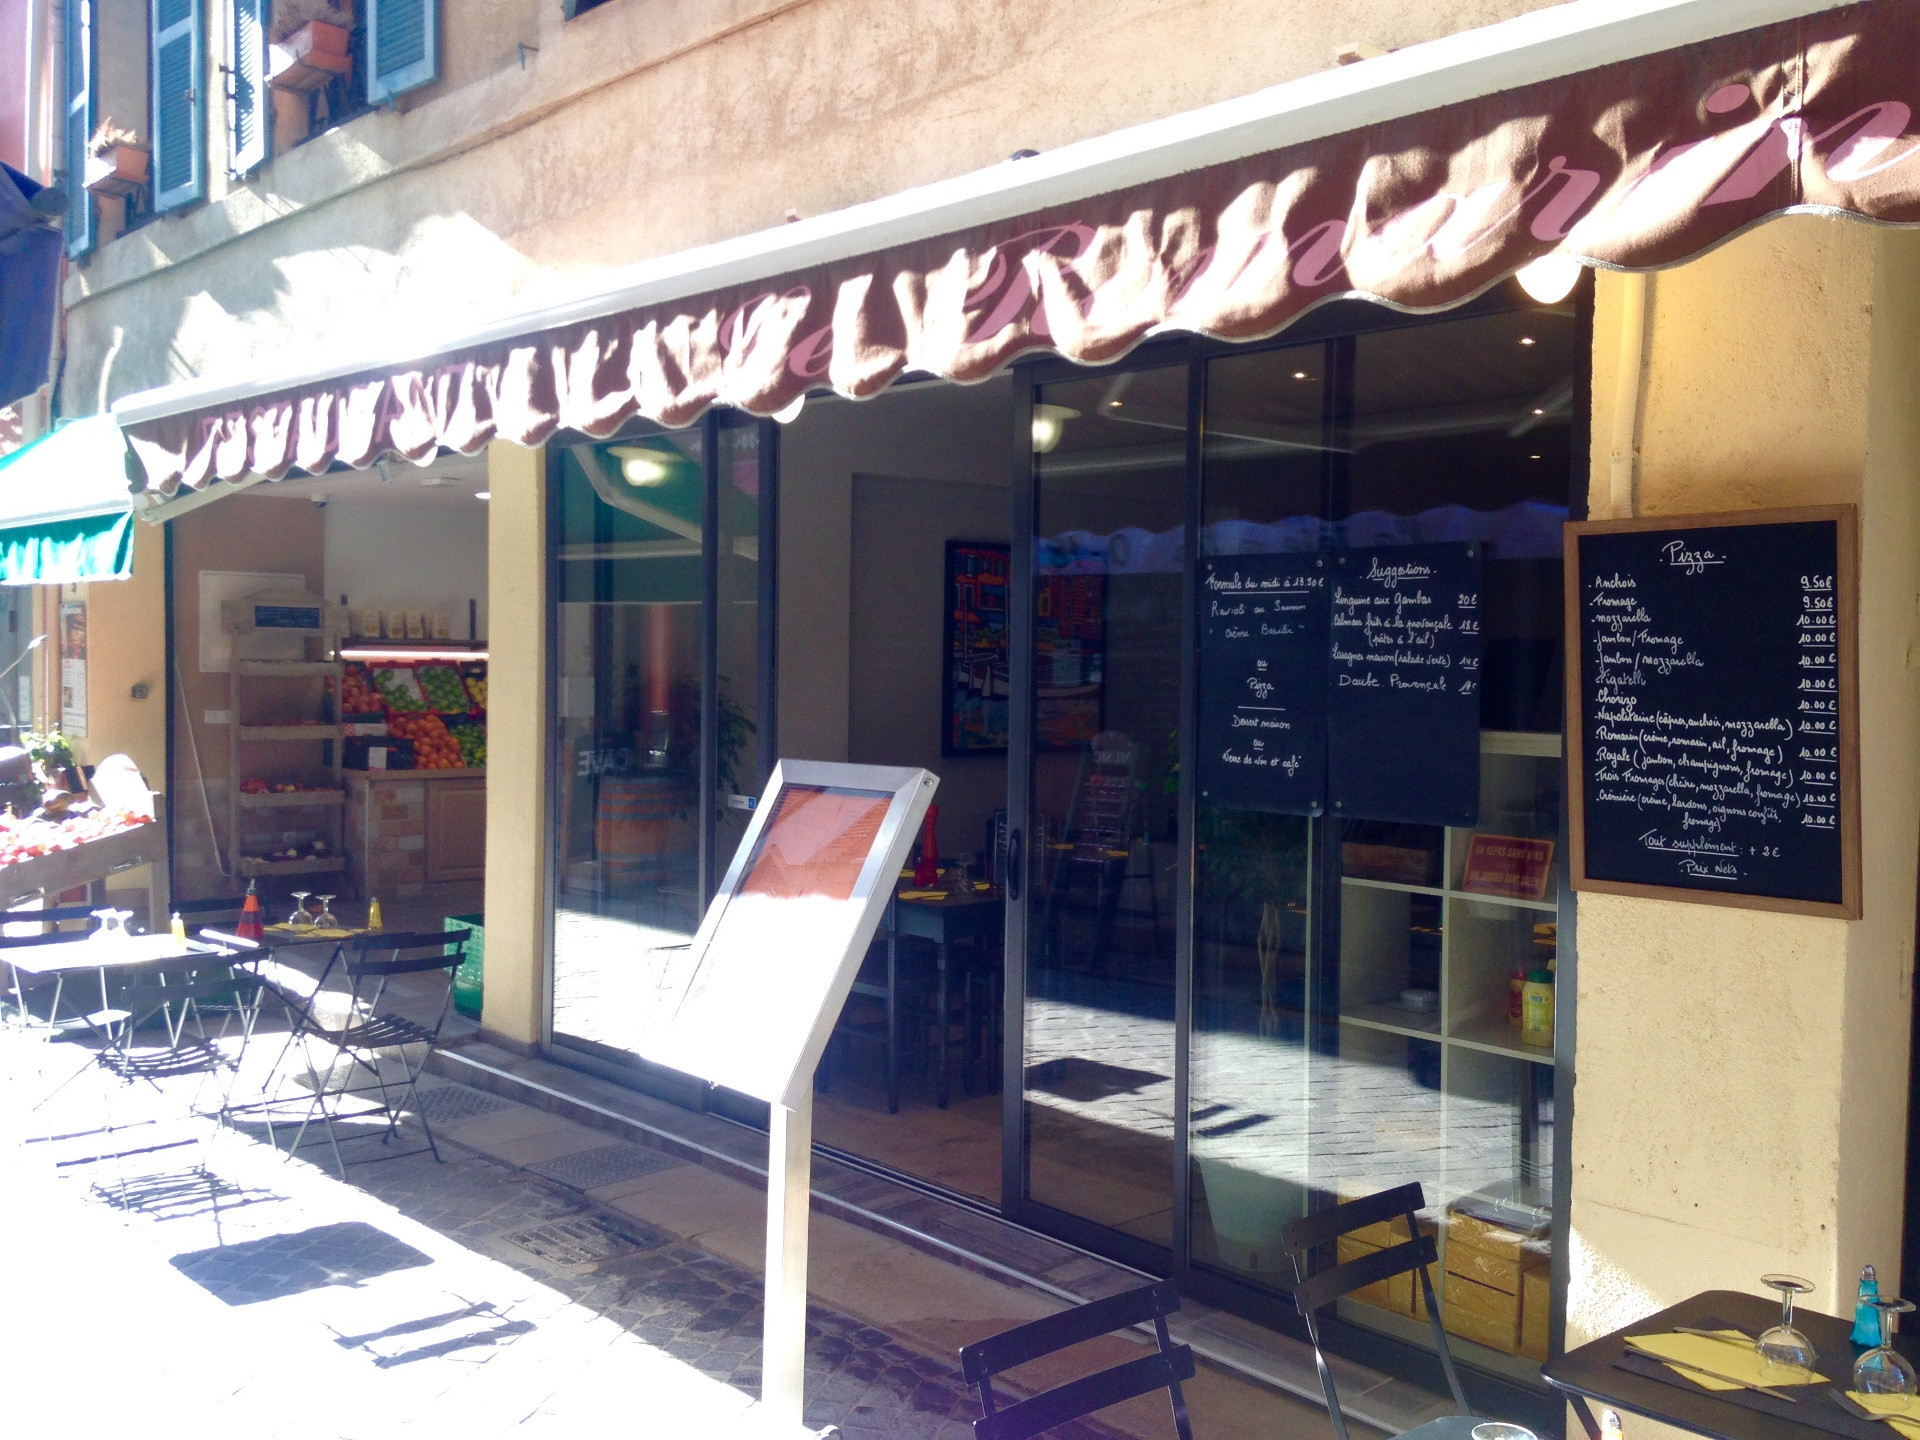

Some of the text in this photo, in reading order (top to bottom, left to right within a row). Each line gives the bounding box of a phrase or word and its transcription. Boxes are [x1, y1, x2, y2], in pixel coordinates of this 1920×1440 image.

[1662, 540, 1716, 576] Pizza
[1205, 571, 1243, 591] Formule
[1245, 576, 1258, 589] du
[1260, 576, 1281, 588] midi
[1283, 576, 1292, 588] à
[1366, 557, 1431, 589] Suggestions
[1595, 572, 1637, 589] Anchois
[1211, 599, 1307, 618] Ravioli au Saumon
[1374, 596, 1391, 605] aux
[1392, 613, 1405, 628] la
[1257, 659, 1268, 667] ou
[1246, 676, 1275, 699] Pizza
[1389, 672, 1447, 692] Provençale
[1231, 714, 1291, 729] Dessert maison
[1243, 753, 1253, 765] de
[1270, 756, 1280, 767] et
[1638, 828, 1667, 849] Tout
[1678, 859, 1709, 874] Prix
